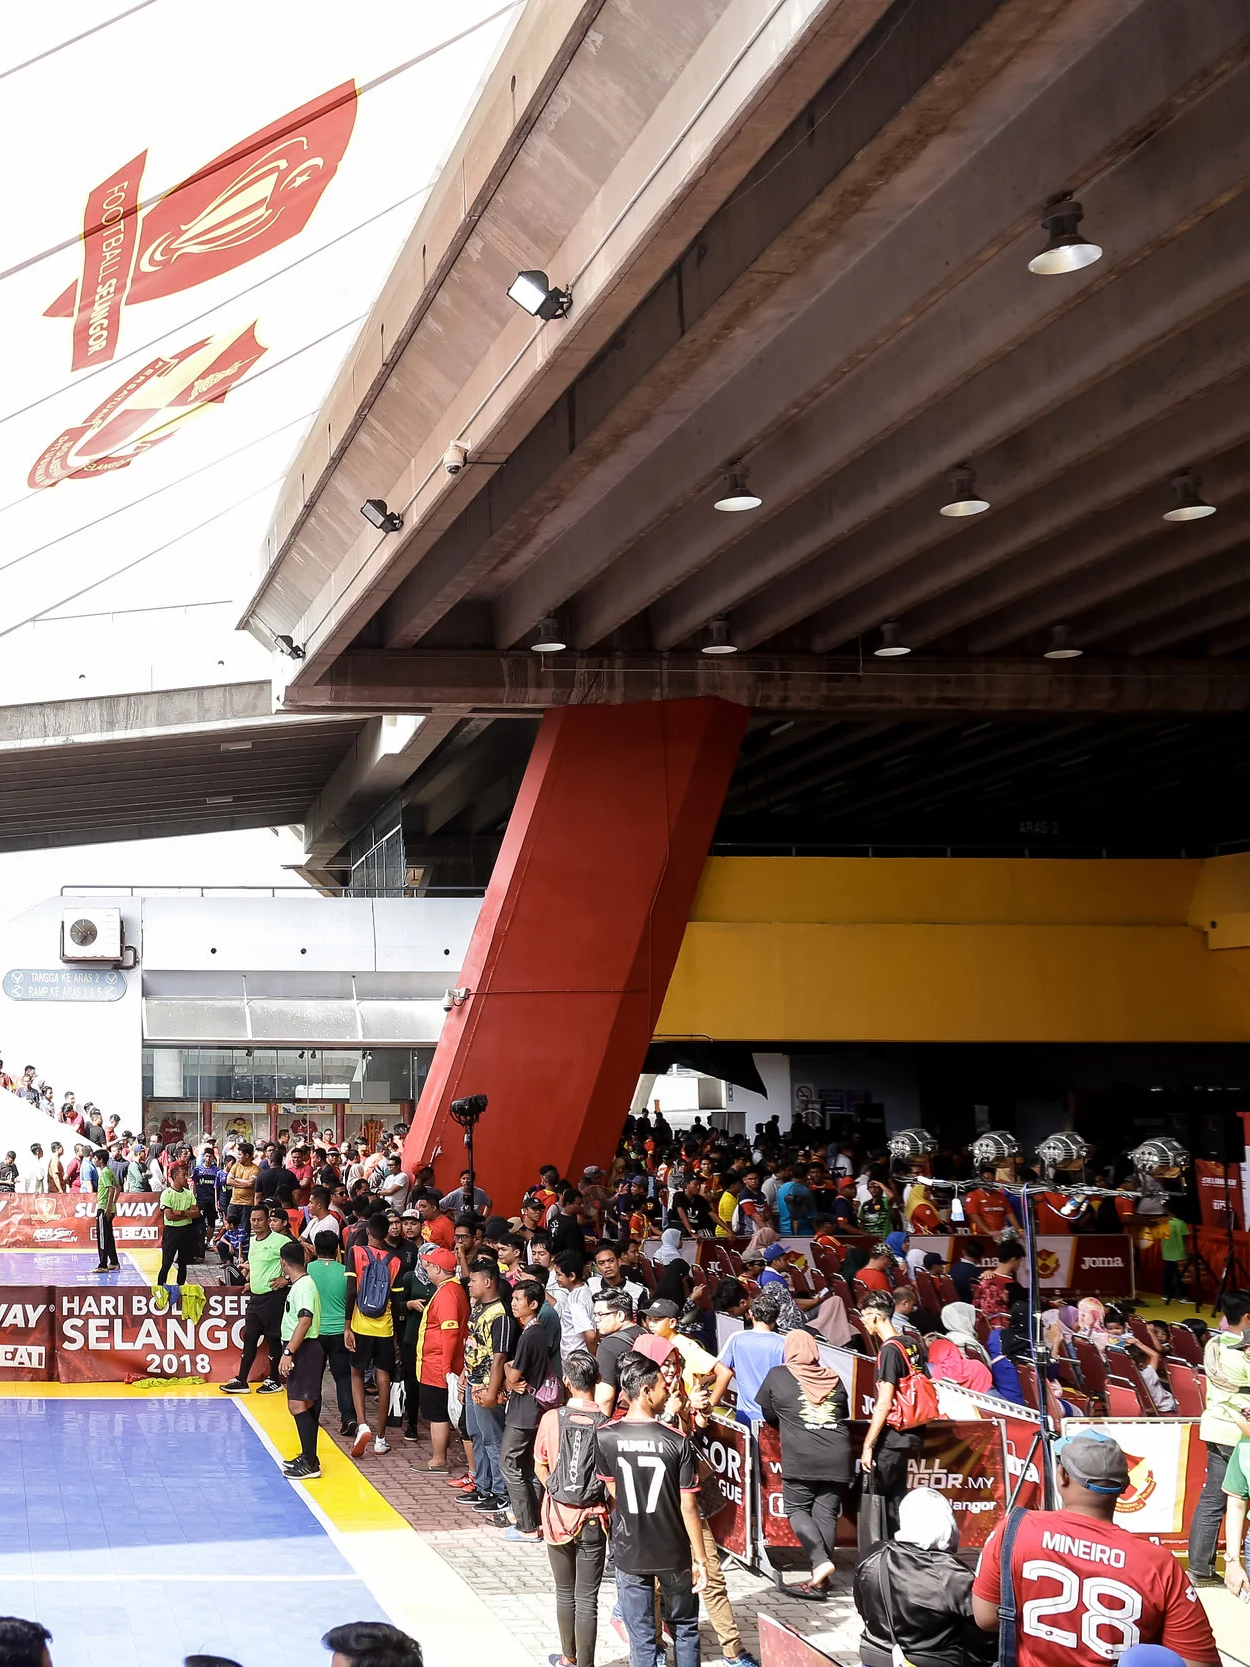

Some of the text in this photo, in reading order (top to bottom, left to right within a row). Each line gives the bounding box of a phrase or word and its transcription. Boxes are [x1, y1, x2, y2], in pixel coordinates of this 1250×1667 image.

[87, 180, 129, 356] FOOTBALL SELANGOR
[28, 986, 49, 997] RAMP
[50, 986, 60, 997] KE
[62, 986, 81, 998] ARAS
[30, 972, 59, 984] TANGGA
[61, 972, 72, 984] KE
[74, 972, 93, 984] ARAS
[75, 1202, 159, 1218] SUWAY
[62, 1295, 124, 1316] HARI
[132, 1295, 182, 1316] BOL
[61, 1317, 265, 1352] SELANGO
[146, 1353, 211, 1375] 2018
[616, 1455, 667, 1514] 17
[1041, 1531, 1127, 1569] MINEIRO
[1021, 1559, 1144, 1660] 28
